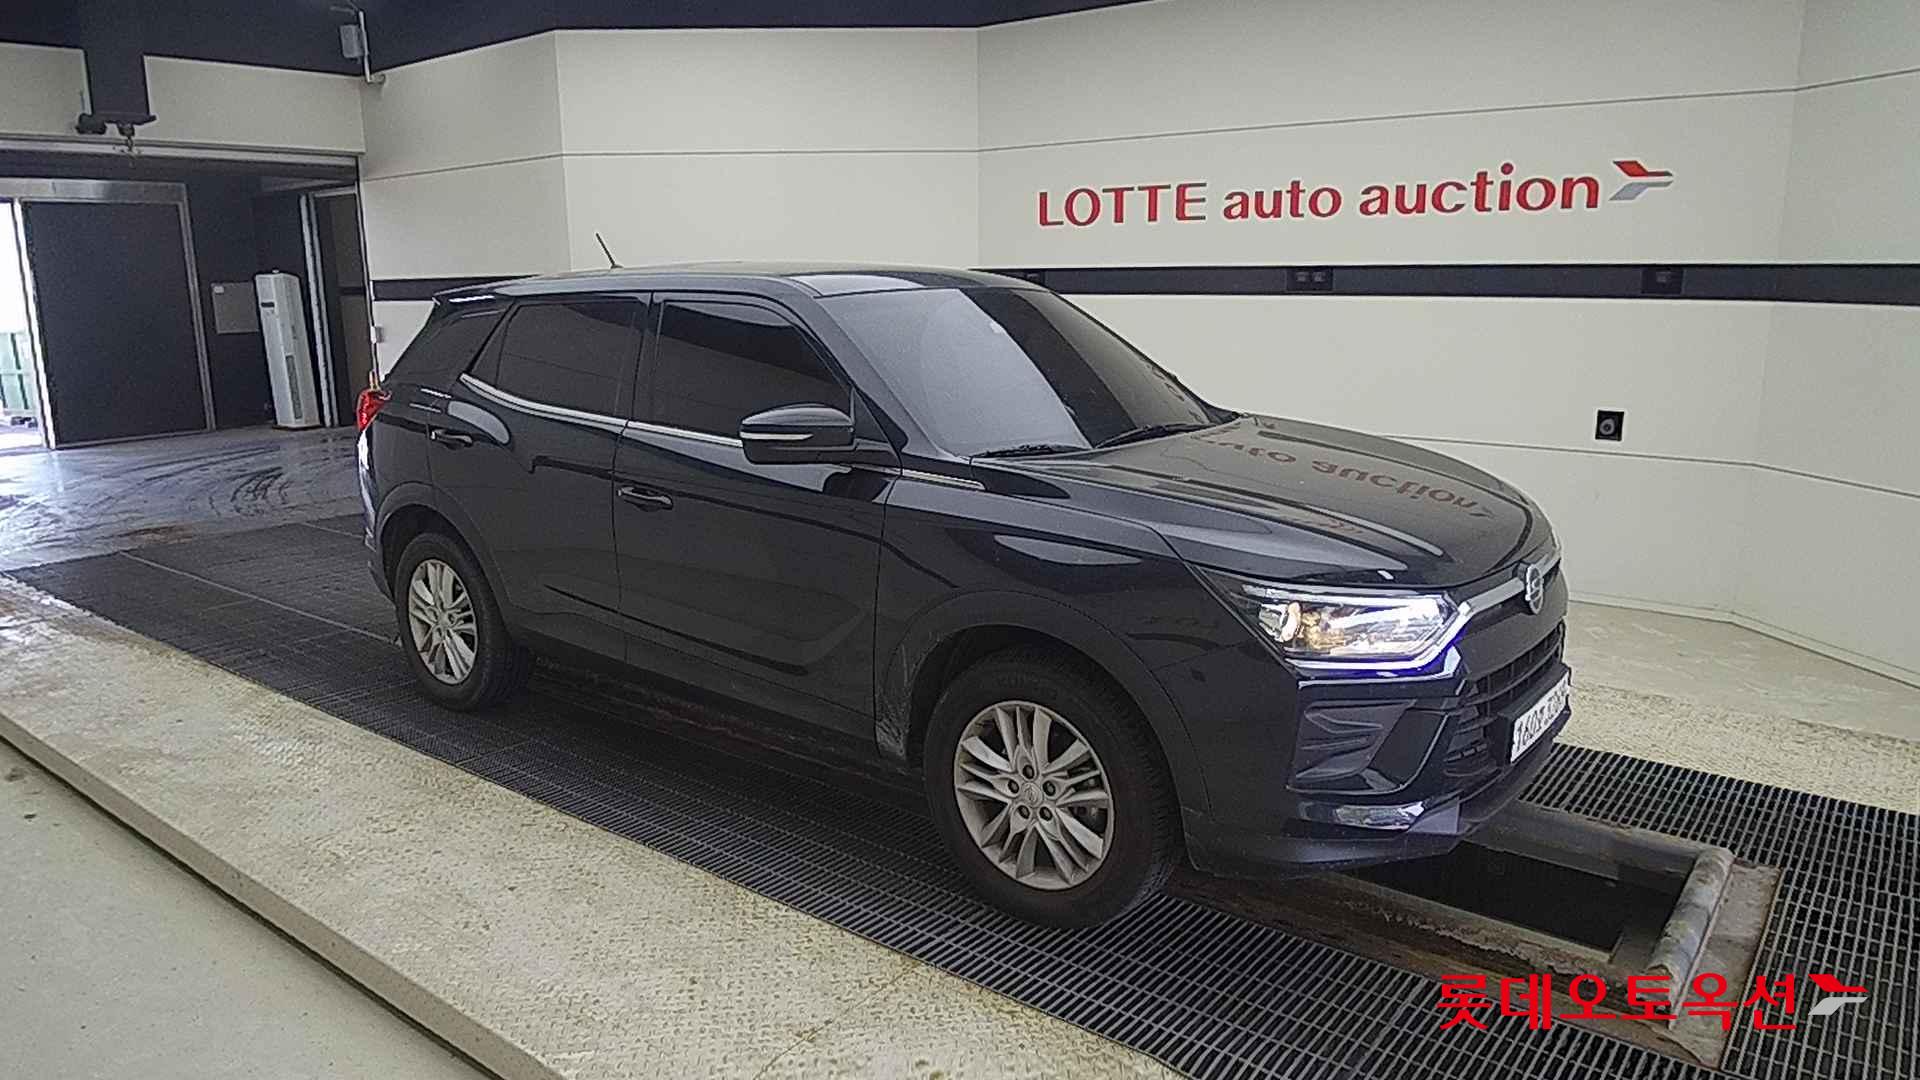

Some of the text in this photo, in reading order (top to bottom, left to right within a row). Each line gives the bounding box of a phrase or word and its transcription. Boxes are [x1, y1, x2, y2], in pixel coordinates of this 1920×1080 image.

[1039, 162, 1600, 226] LOTTE auto auction
